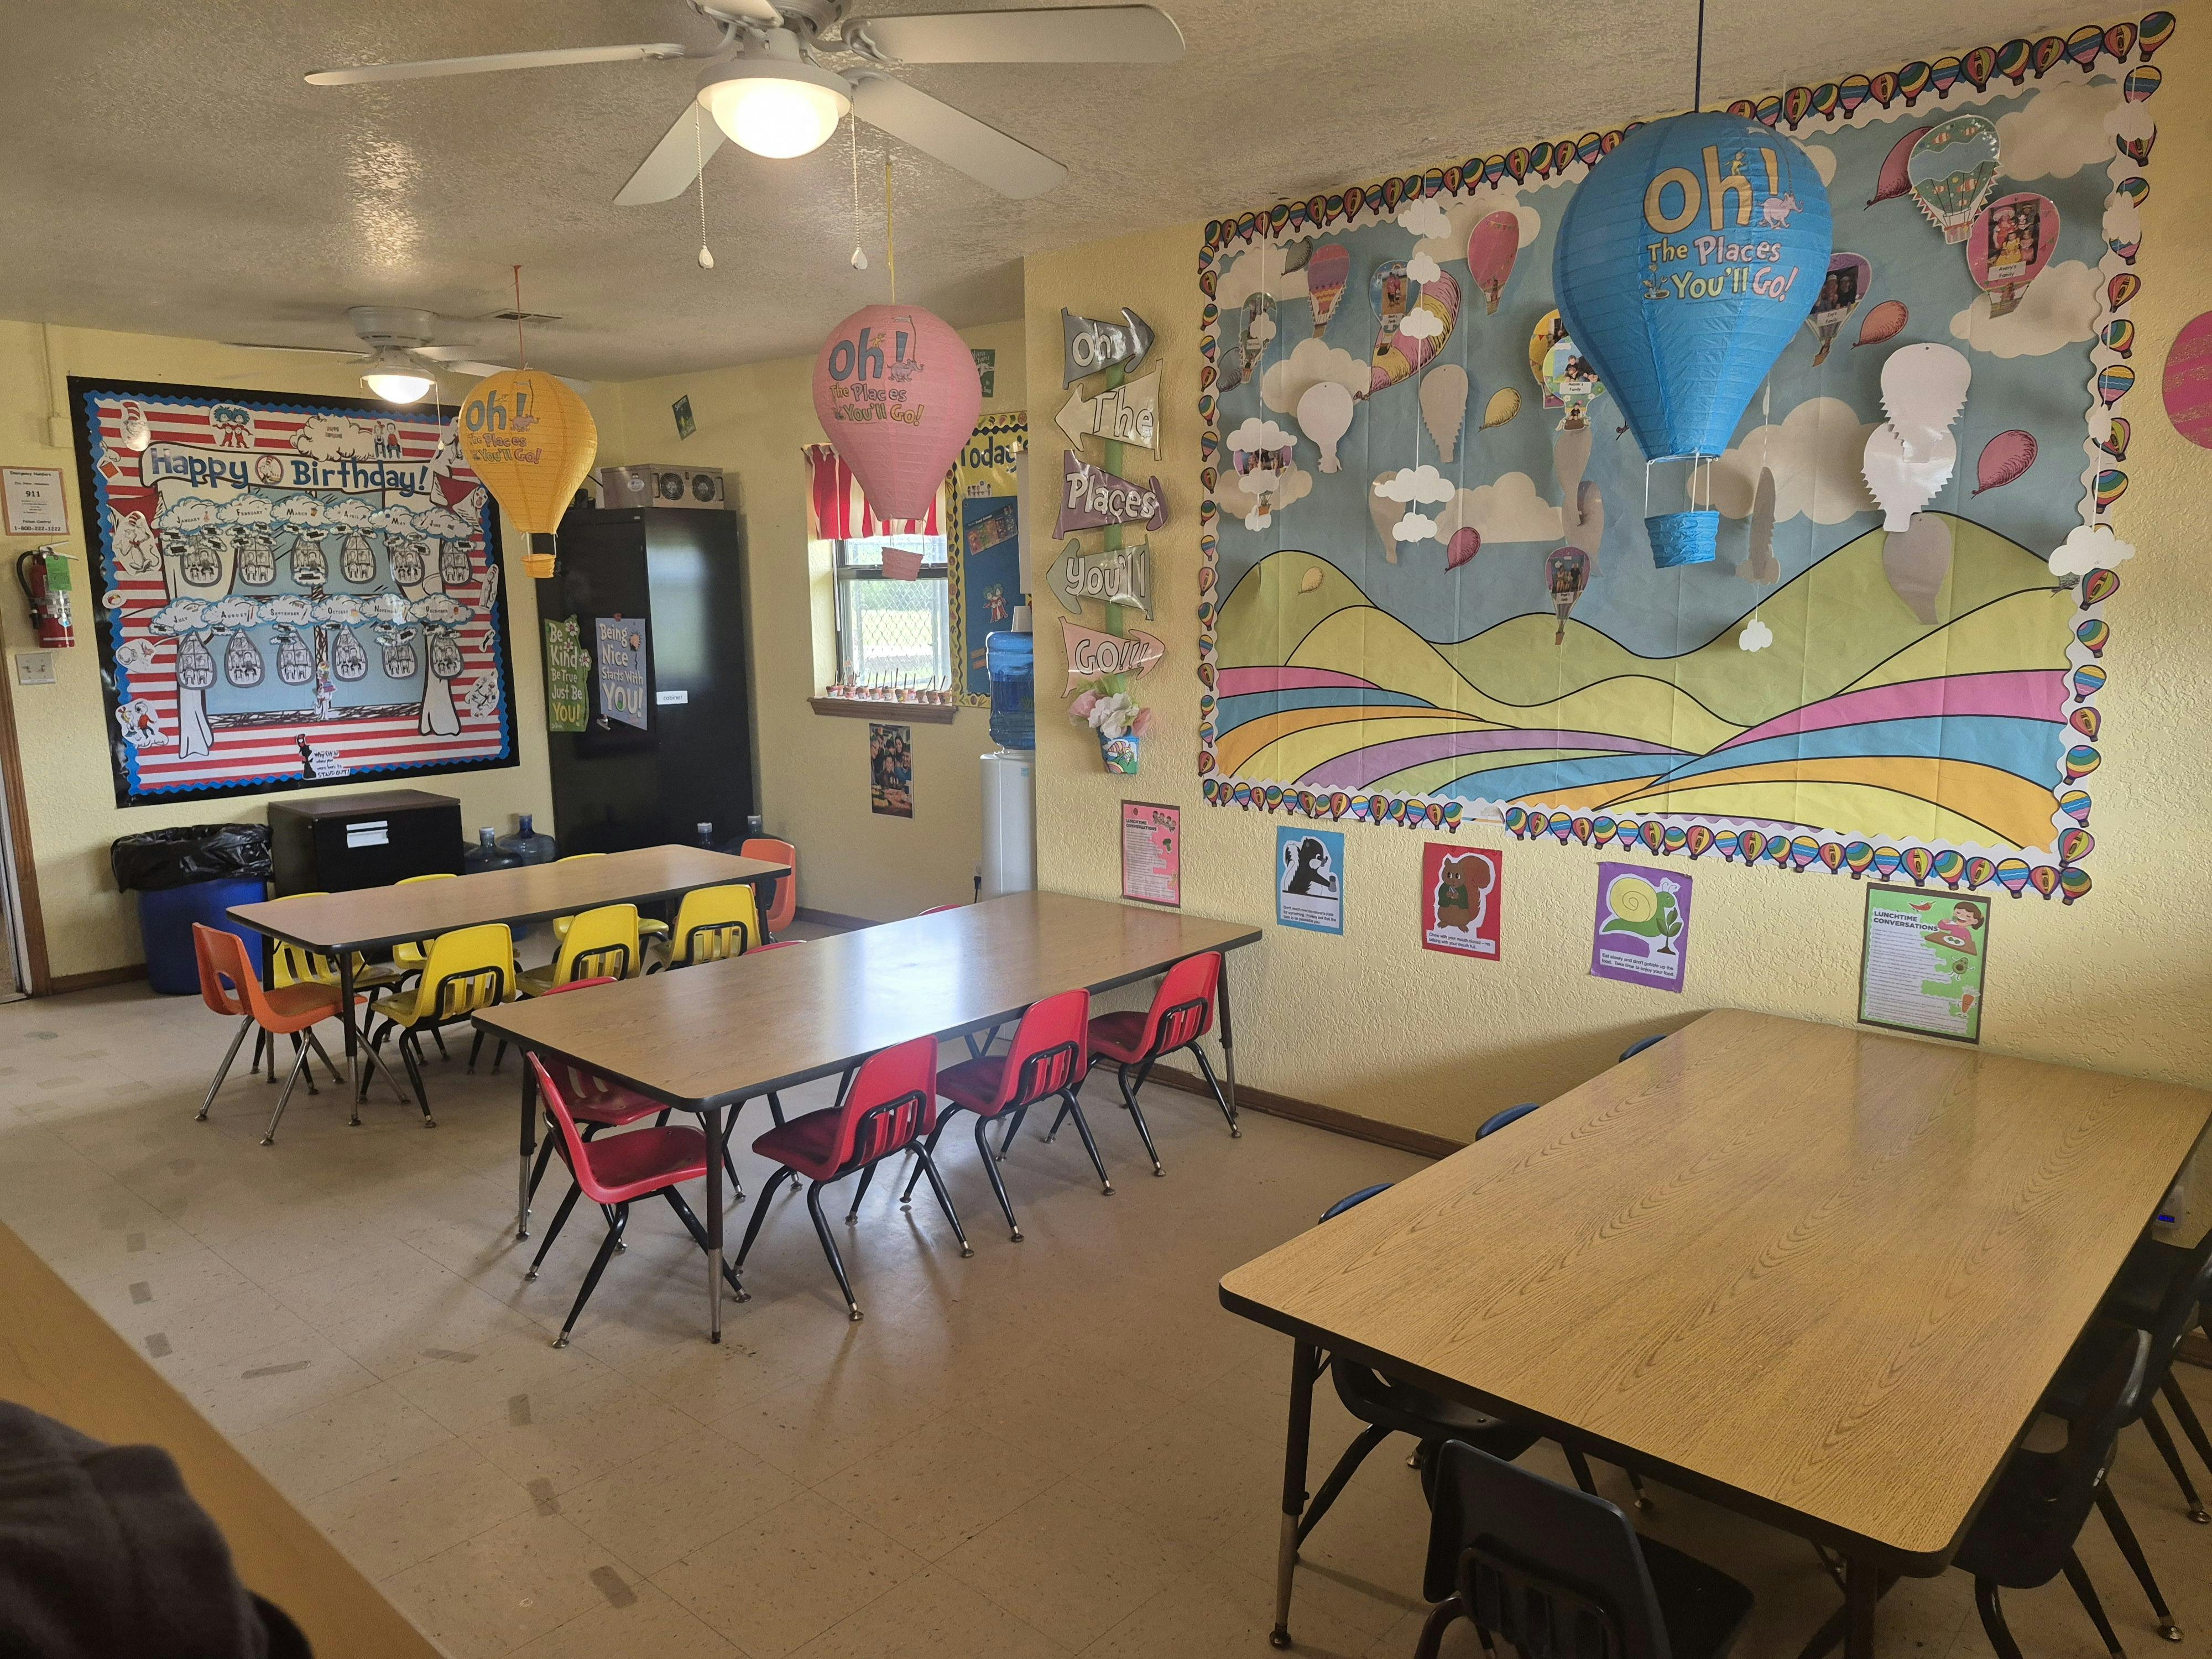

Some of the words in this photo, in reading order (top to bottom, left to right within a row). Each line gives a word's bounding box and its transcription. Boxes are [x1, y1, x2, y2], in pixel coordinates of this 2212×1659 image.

[1647, 238, 1688, 263] The
[1693, 236, 1782, 266] Places
[1671, 267, 1750, 299] You'll
[1752, 266, 1799, 302] Go!
[830, 383, 849, 398] The
[851, 383, 907, 403] Places
[843, 403, 887, 421] You'll
[890, 404, 925, 426] Go!
[1093, 386, 1154, 439] The
[483, 433, 527, 447] Places
[478, 448, 513, 462] You'll
[515, 448, 542, 465] Go!
[152, 448, 248, 489] Happy
[291, 457, 429, 497] Birthday!
[1066, 473, 1157, 518] Places
[549, 623, 563, 643] Be
[599, 623, 628, 648] Being
[550, 644, 577, 670] Kind
[602, 644, 628, 667] Nice
[551, 668, 561, 681] Be
[561, 669, 577, 683] True
[602, 666, 624, 682] Starts
[624, 671, 643, 686] With
[552, 684, 568, 700] Just
[571, 685, 582, 700] Be
[602, 682, 644, 718] YOU!
[553, 702, 581, 727] YOU!
[1874, 911, 1918, 922] LUNCHTIME
[1874, 917, 1938, 931] CONVERSATIONS
